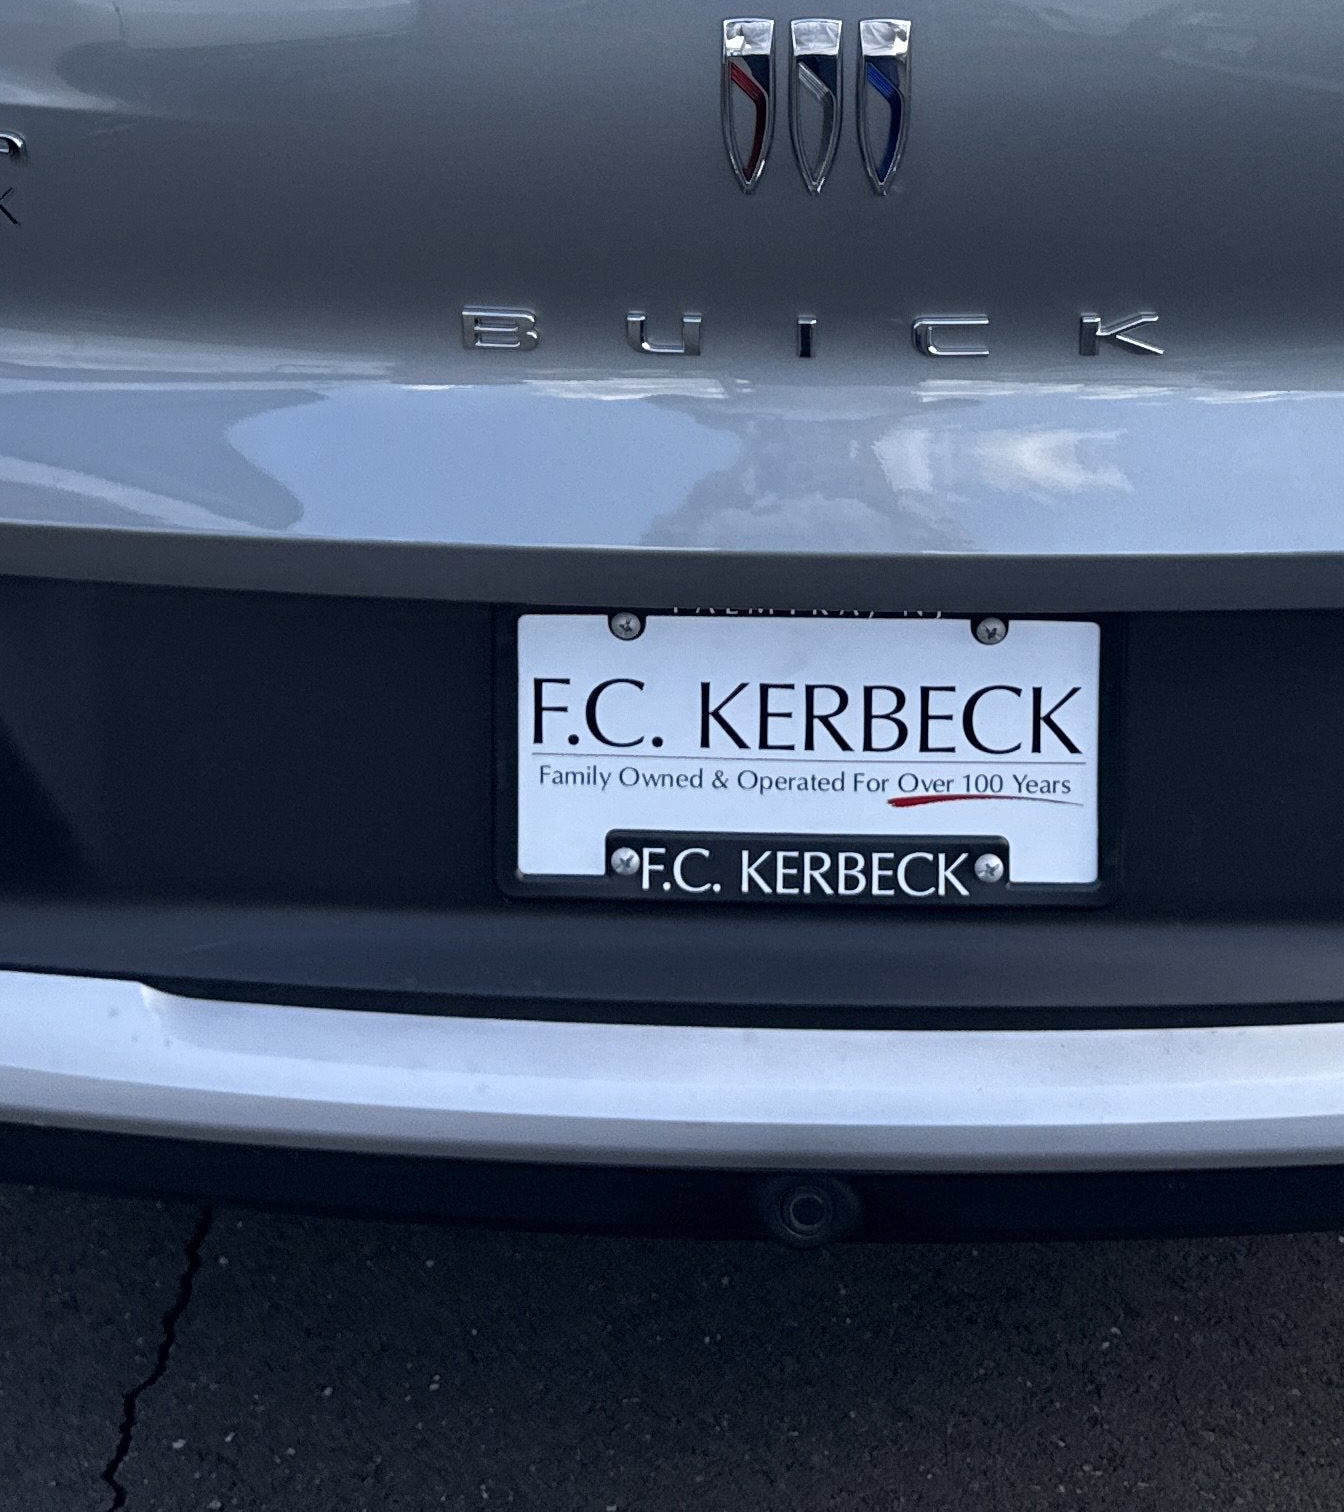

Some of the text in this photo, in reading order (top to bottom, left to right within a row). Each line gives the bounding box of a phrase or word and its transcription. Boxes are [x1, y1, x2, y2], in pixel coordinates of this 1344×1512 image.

[460, 304, 1165, 360] BUICK
[532, 676, 1084, 756] F.C. KERBECK
[539, 764, 1071, 795] Family Owned & Operated For Over 100 Years
[640, 846, 971, 897] F.C. KERBECK
